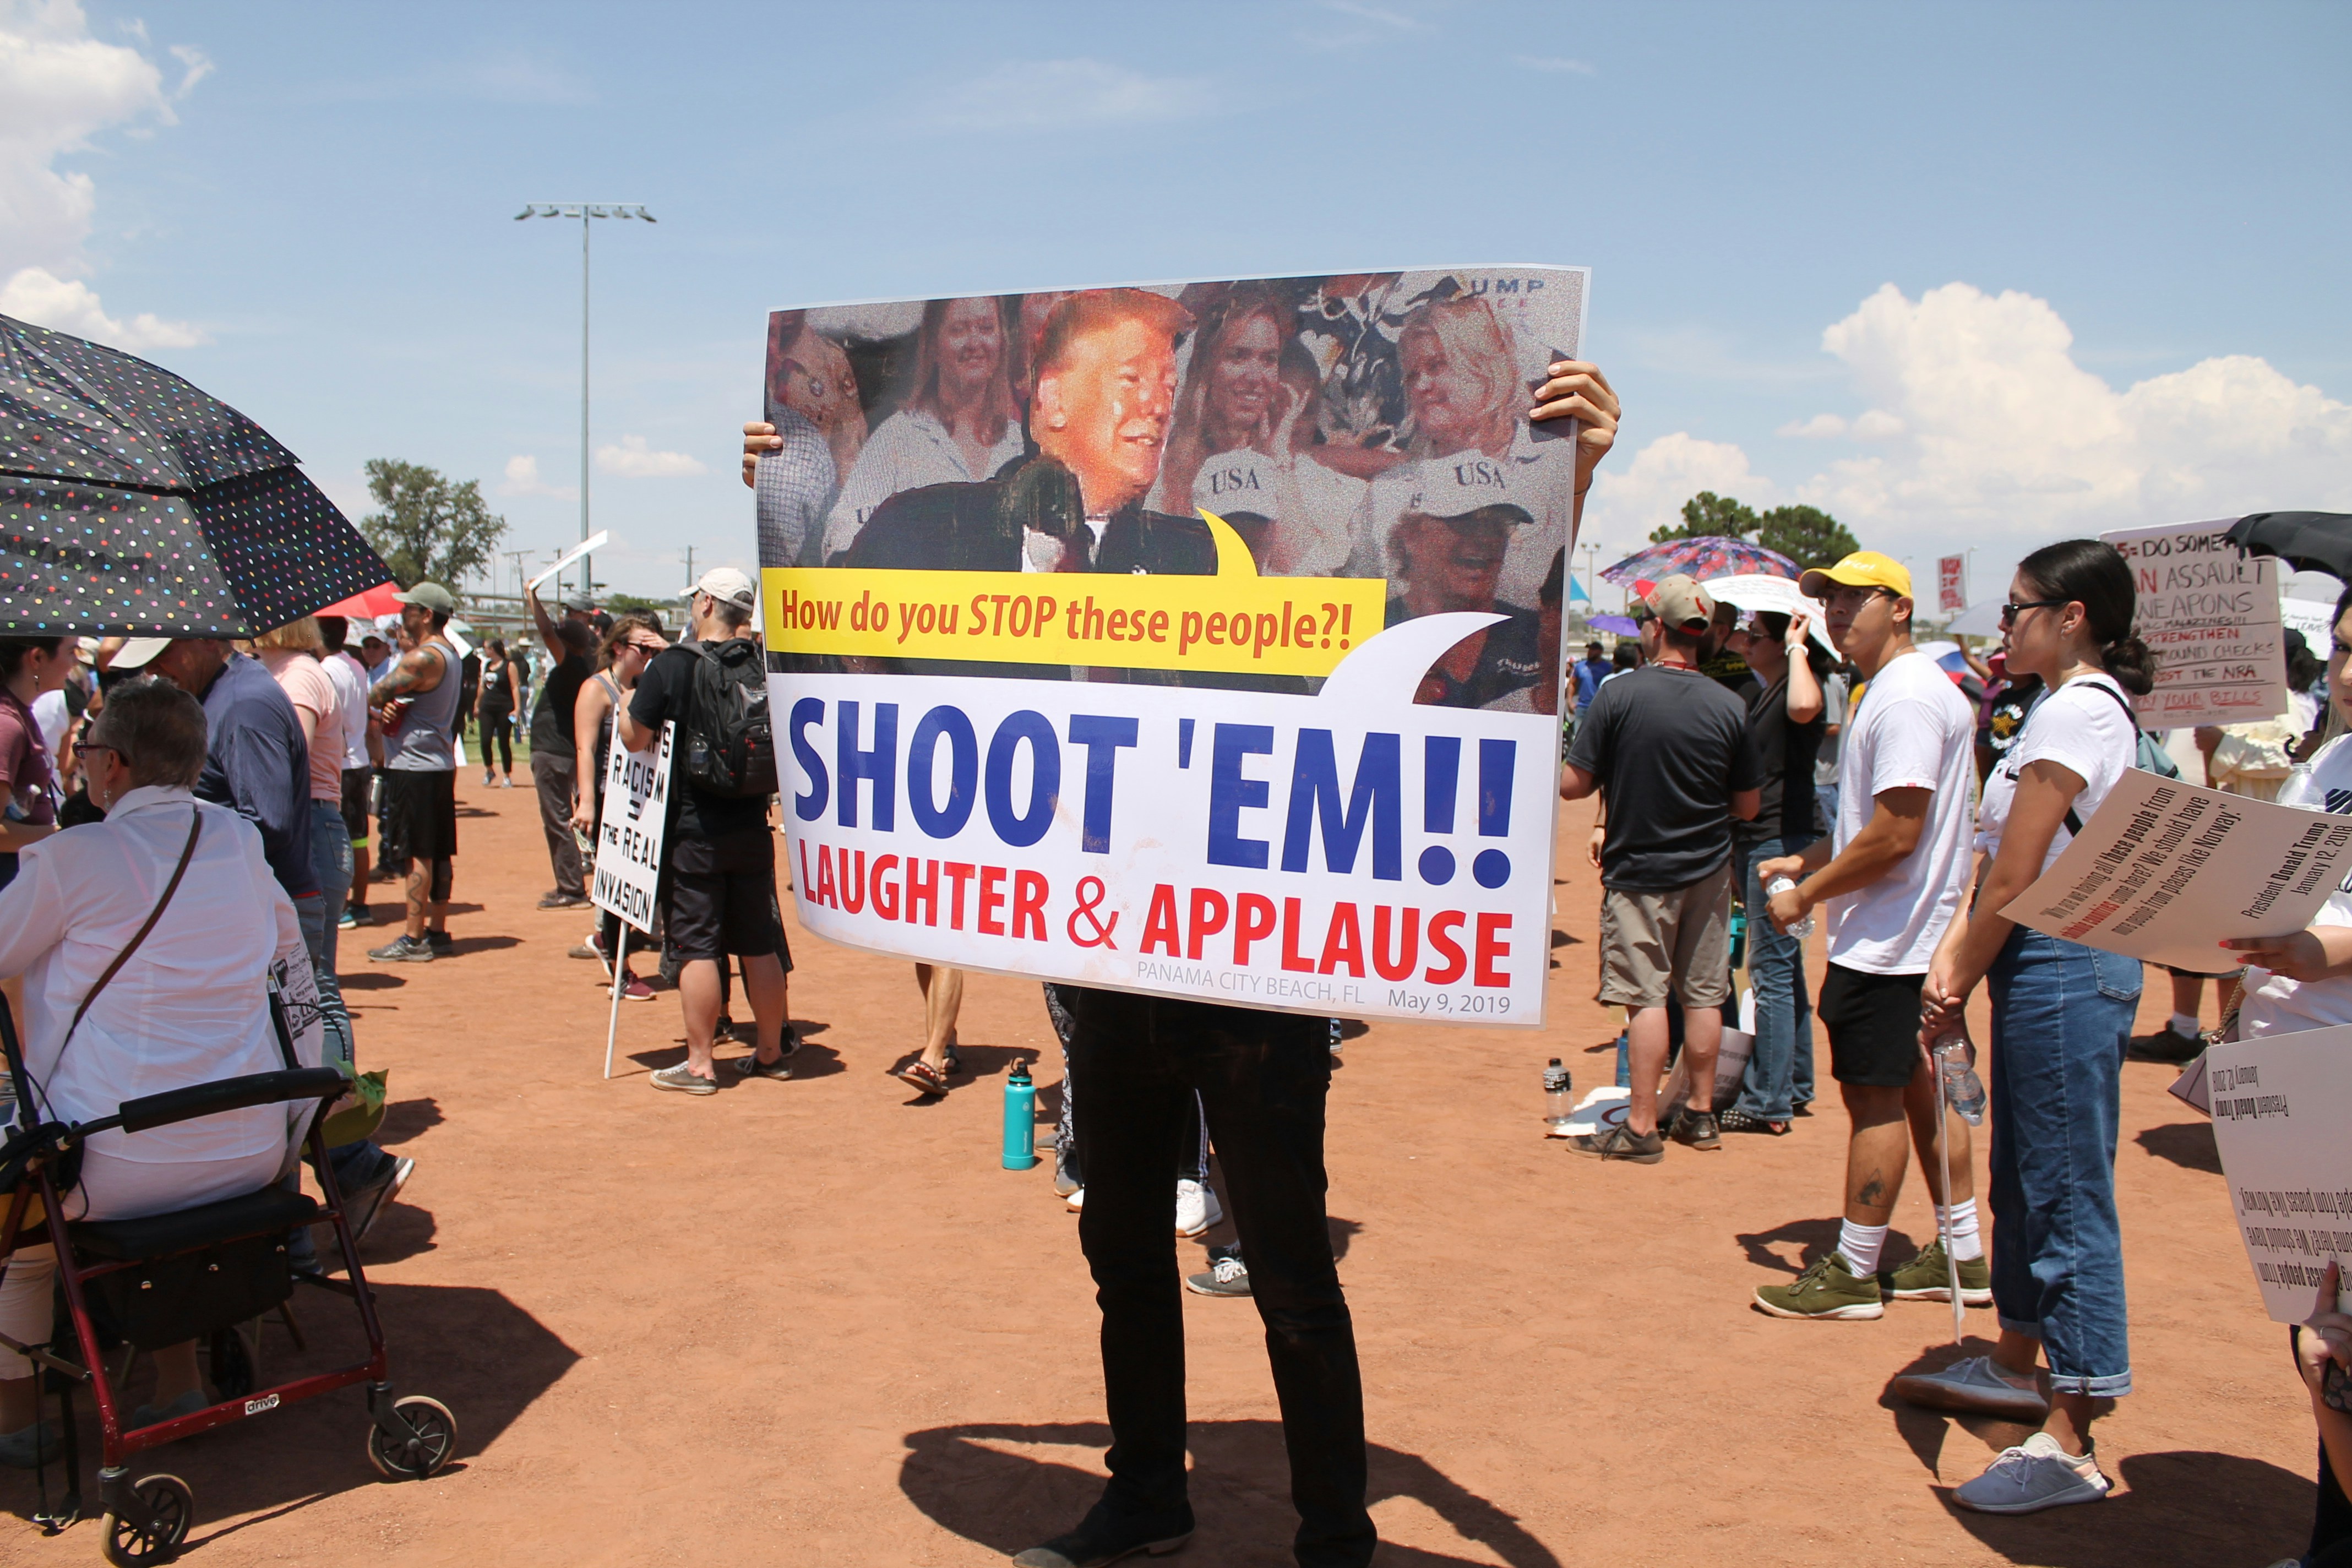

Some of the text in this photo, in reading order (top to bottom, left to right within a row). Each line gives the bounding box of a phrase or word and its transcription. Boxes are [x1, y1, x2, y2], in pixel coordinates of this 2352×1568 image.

[1211, 468, 1260, 495] USA
[1455, 461, 1506, 489] USA
[2142, 537, 2171, 558] DO
[2165, 558, 2272, 591] ASSAULT
[782, 589, 1353, 659] How do you STOP these people?!
[2213, 642, 2275, 659] CHECKS
[2222, 664, 2256, 680] NRA
[612, 753, 665, 804] RACISM
[789, 696, 1517, 890] SHOOT 'EM!!
[2139, 787, 2177, 812] from
[2173, 796, 2210, 822] have
[2122, 809, 2159, 843] people
[2153, 819, 2192, 853] should
[602, 823, 657, 872] THE REAL
[2098, 840, 2136, 864] these
[2137, 850, 2168, 867] We
[2177, 848, 2211, 868] like
[2290, 825, 2352, 896] January 12, 2018
[2093, 859, 2117, 875] all
[2119, 863, 2155, 889] here?
[2159, 865, 2197, 896] places
[2241, 822, 2330, 919] President Donald Trump
[594, 867, 651, 925] INVASION
[2108, 885, 2137, 905] come
[2139, 891, 2174, 910] from
[798, 837, 1513, 989] LAUGHTER & APPLAUSE
[1136, 961, 1511, 1016] PANAMA CITY BEACH, FL May 9, 2019
[2235, 1065, 2259, 1088] January
[2234, 1097, 2257, 1120] Donald
[2256, 1095, 2289, 1118] President
[2269, 1191, 2290, 1218] like
[2285, 1188, 2316, 1219] places
[2312, 1192, 2339, 1220] from
[2246, 1227, 2271, 1253] have
[2266, 1228, 2296, 1255] should
[2293, 1229, 2313, 1256] We
[2309, 1229, 2338, 1259] here?
[2257, 1262, 2281, 1289] from
[2277, 1260, 2307, 1291] people
[247, 1397, 277, 1412] drive
